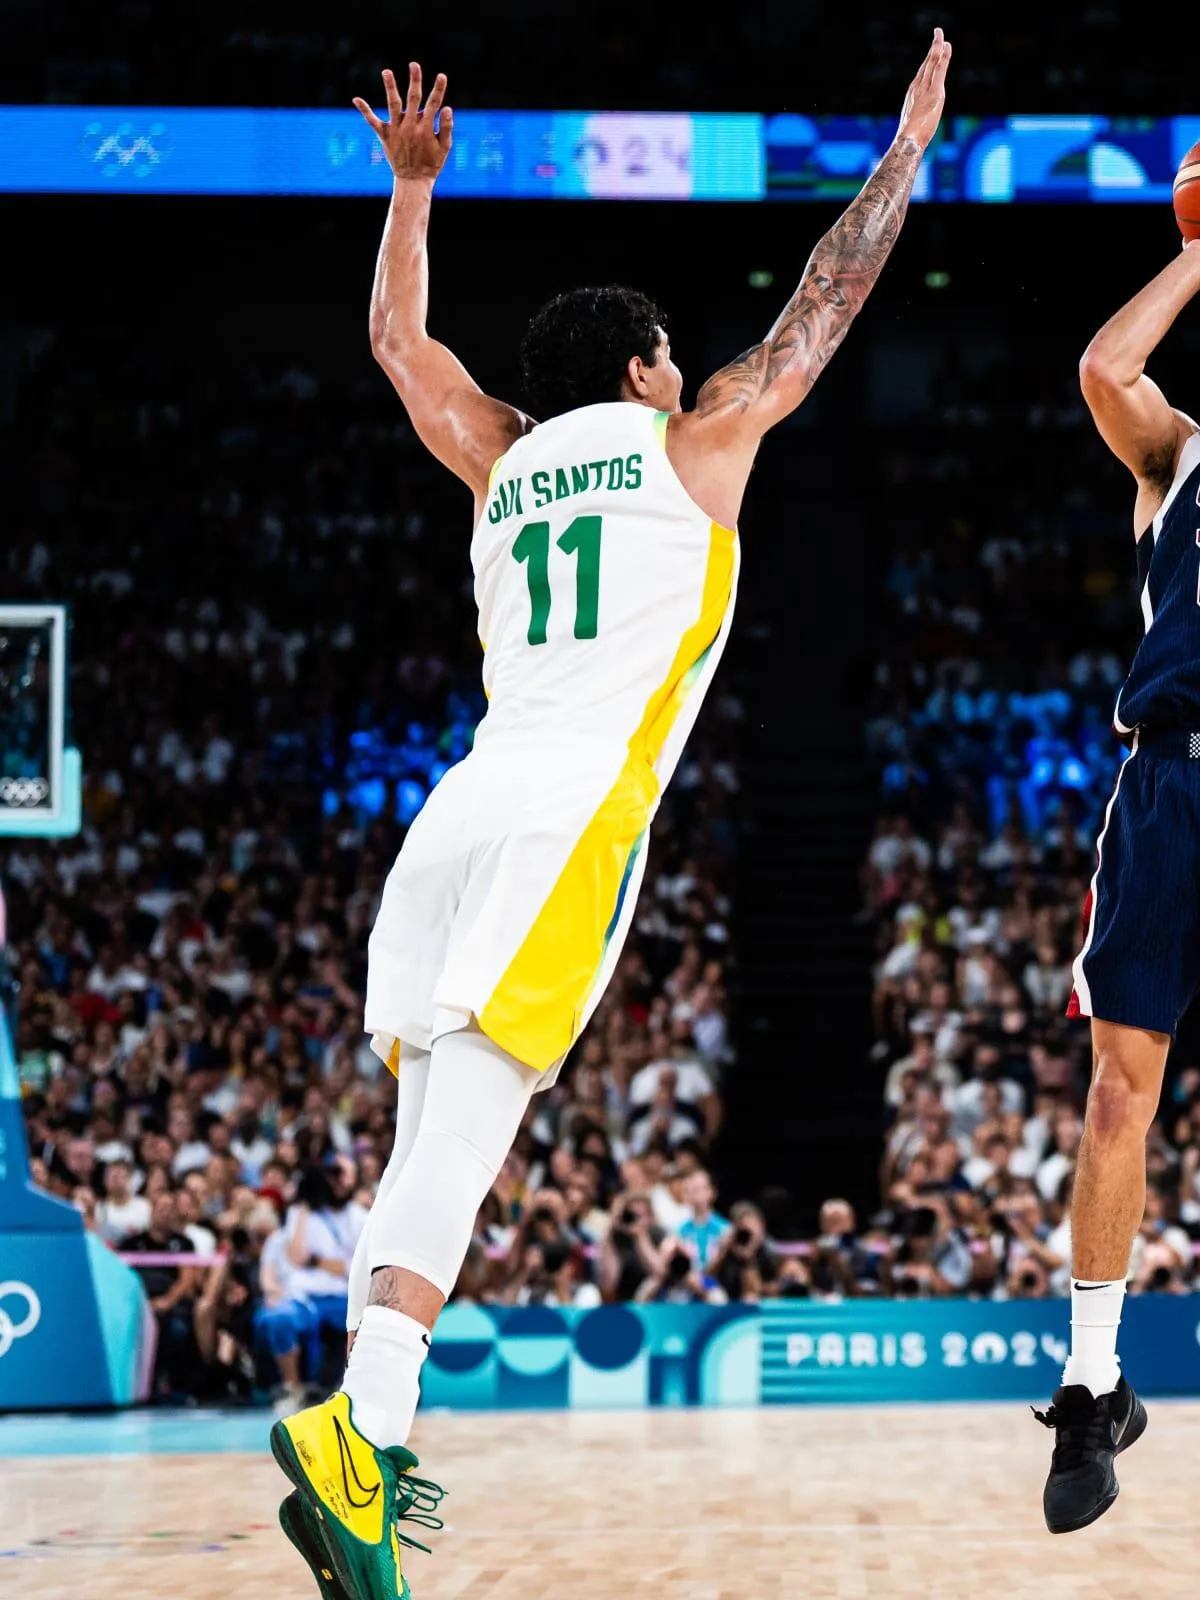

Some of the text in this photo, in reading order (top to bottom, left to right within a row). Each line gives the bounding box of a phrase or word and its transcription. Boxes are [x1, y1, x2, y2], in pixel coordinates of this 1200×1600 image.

[530, 453, 642, 508] SANTOS
[511, 515, 602, 646] 11
[786, 1331, 928, 1367] PARIS
